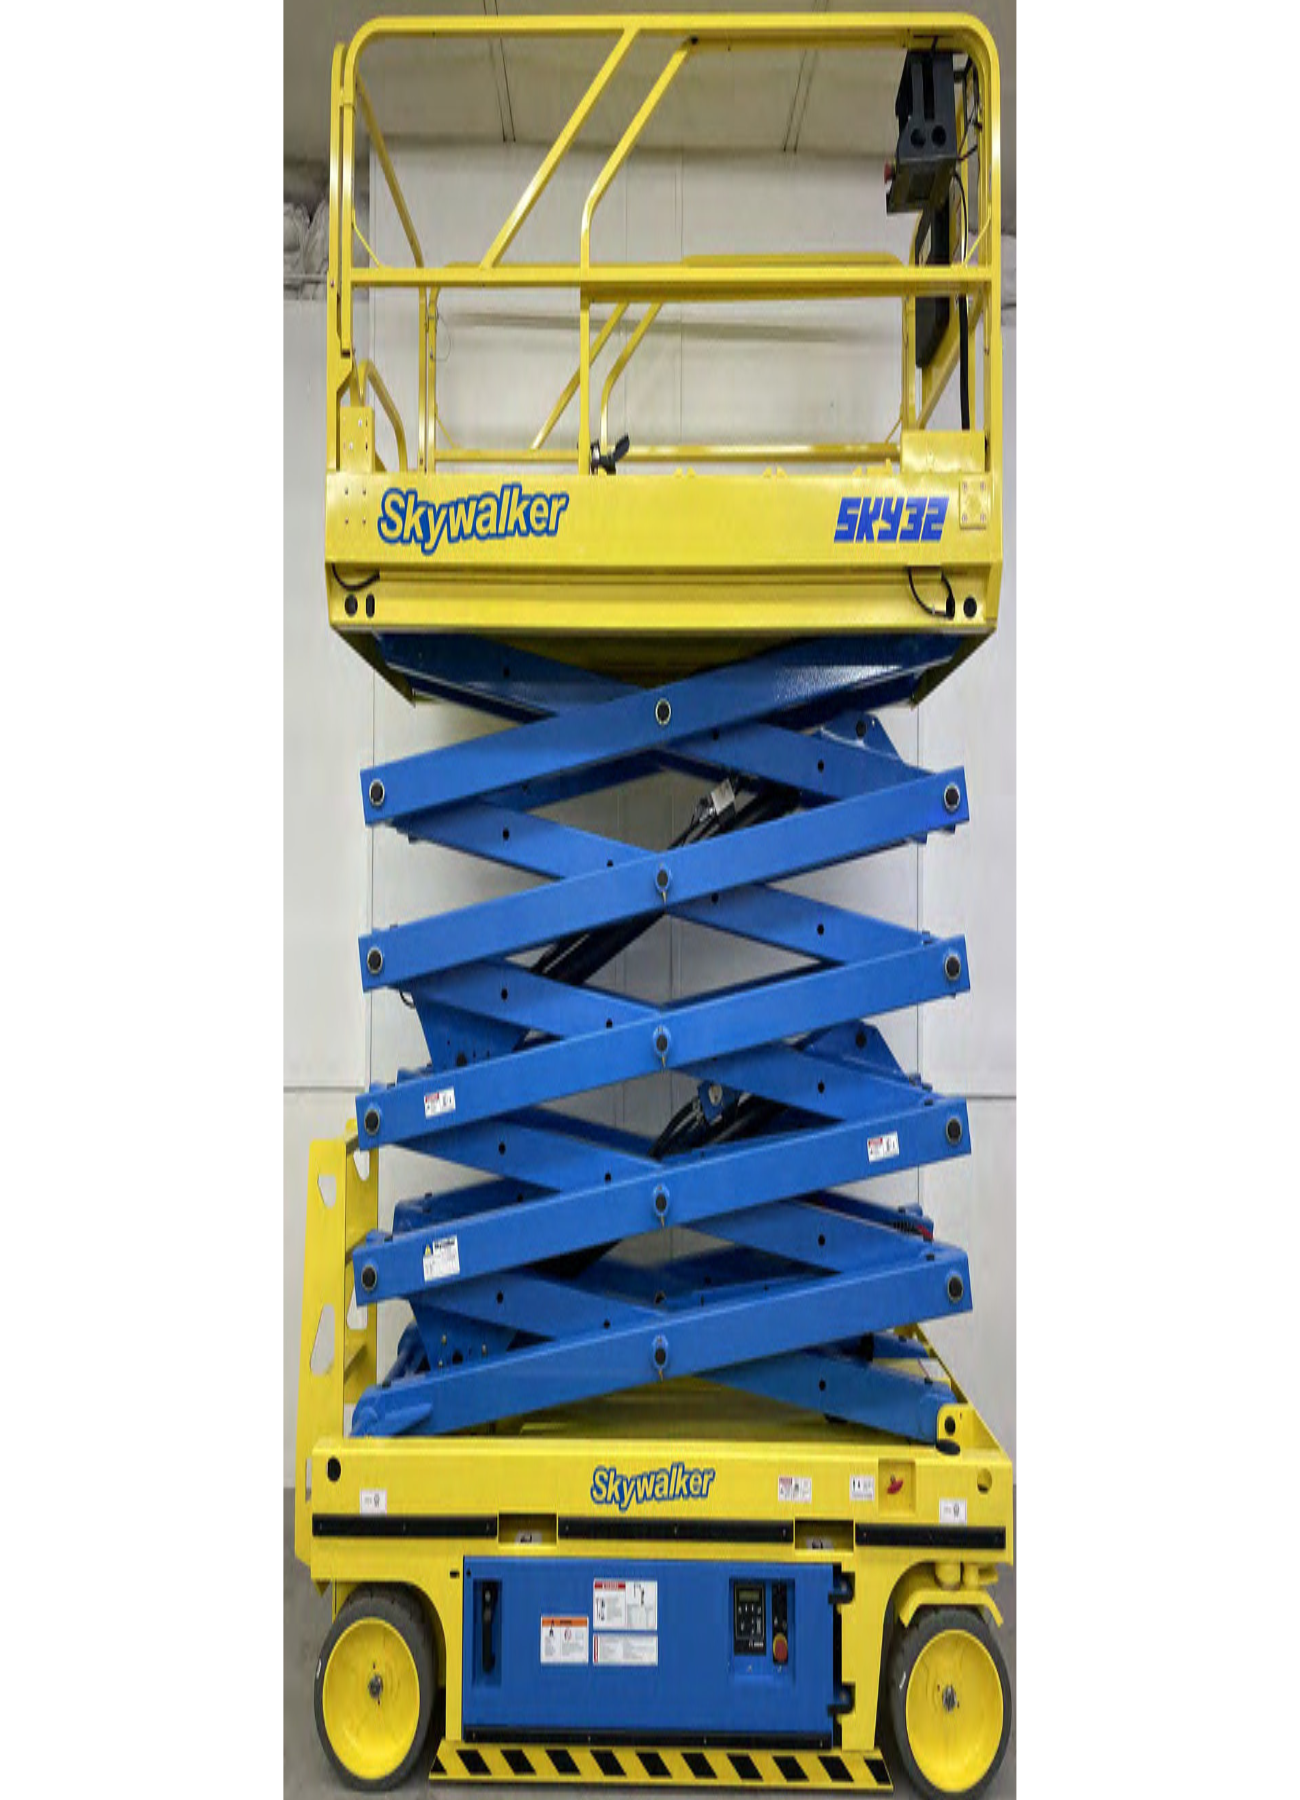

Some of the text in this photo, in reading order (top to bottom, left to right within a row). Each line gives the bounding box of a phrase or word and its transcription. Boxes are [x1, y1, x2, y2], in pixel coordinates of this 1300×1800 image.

[378, 483, 569, 556] Skywalker
[834, 496, 949, 543] SKY32
[591, 1462, 716, 1512] Skywalker
